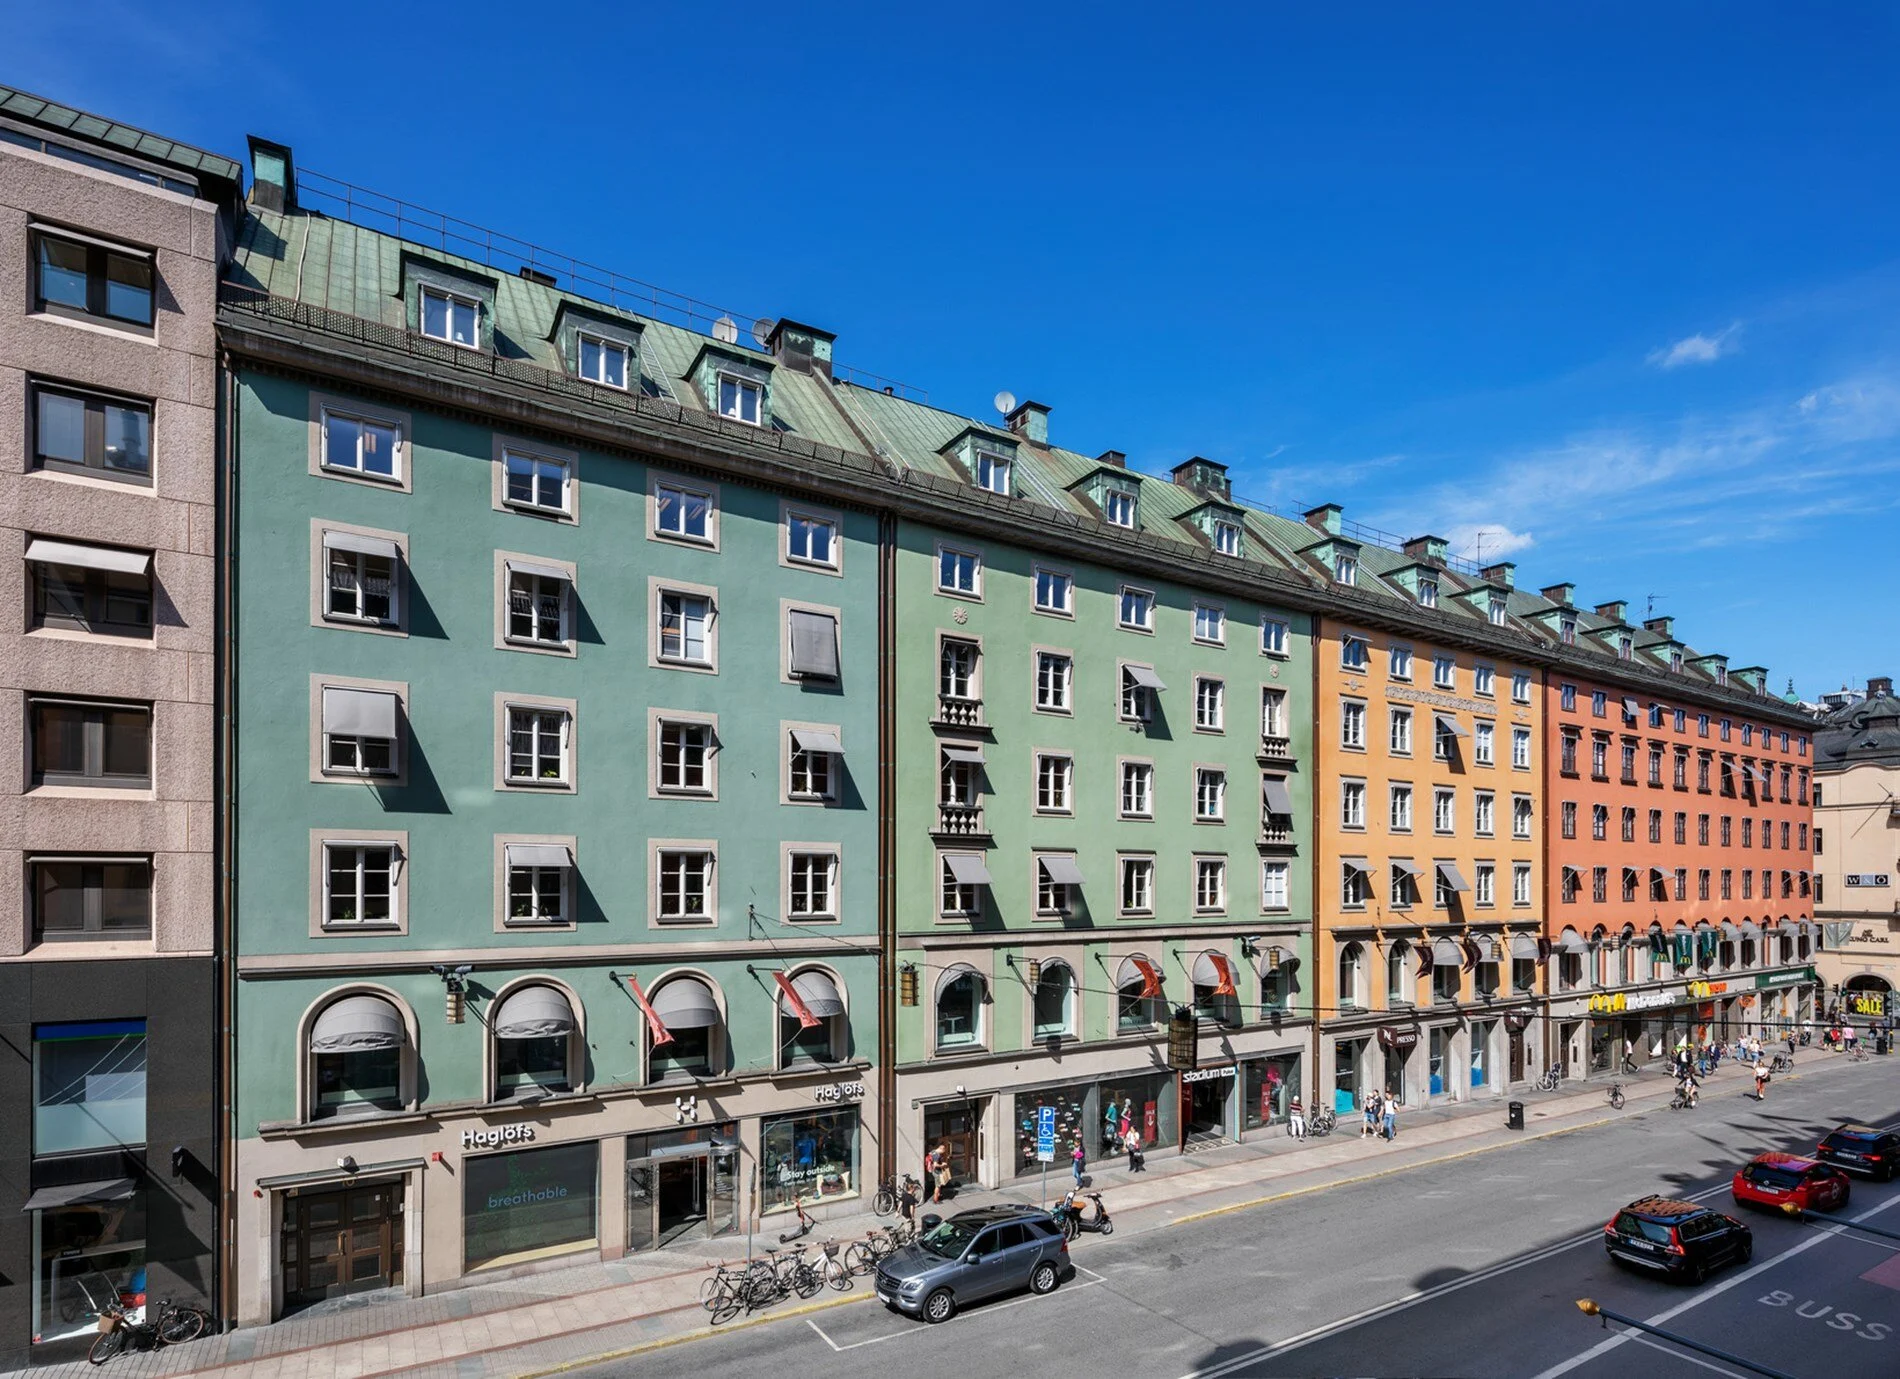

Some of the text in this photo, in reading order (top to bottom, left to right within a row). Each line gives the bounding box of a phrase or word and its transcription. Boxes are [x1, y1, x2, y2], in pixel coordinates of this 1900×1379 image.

[1856, 997, 1882, 1014] SALE
[1183, 1069, 1220, 1083] stadium
[815, 1082, 863, 1099] Haglöfs
[1043, 1108, 1052, 1121] P
[461, 1123, 532, 1146] Haglöfs
[787, 1164, 835, 1179] Stay outside
[488, 1186, 568, 1208] breathable
[1757, 1290, 1893, 1341] BUSS
